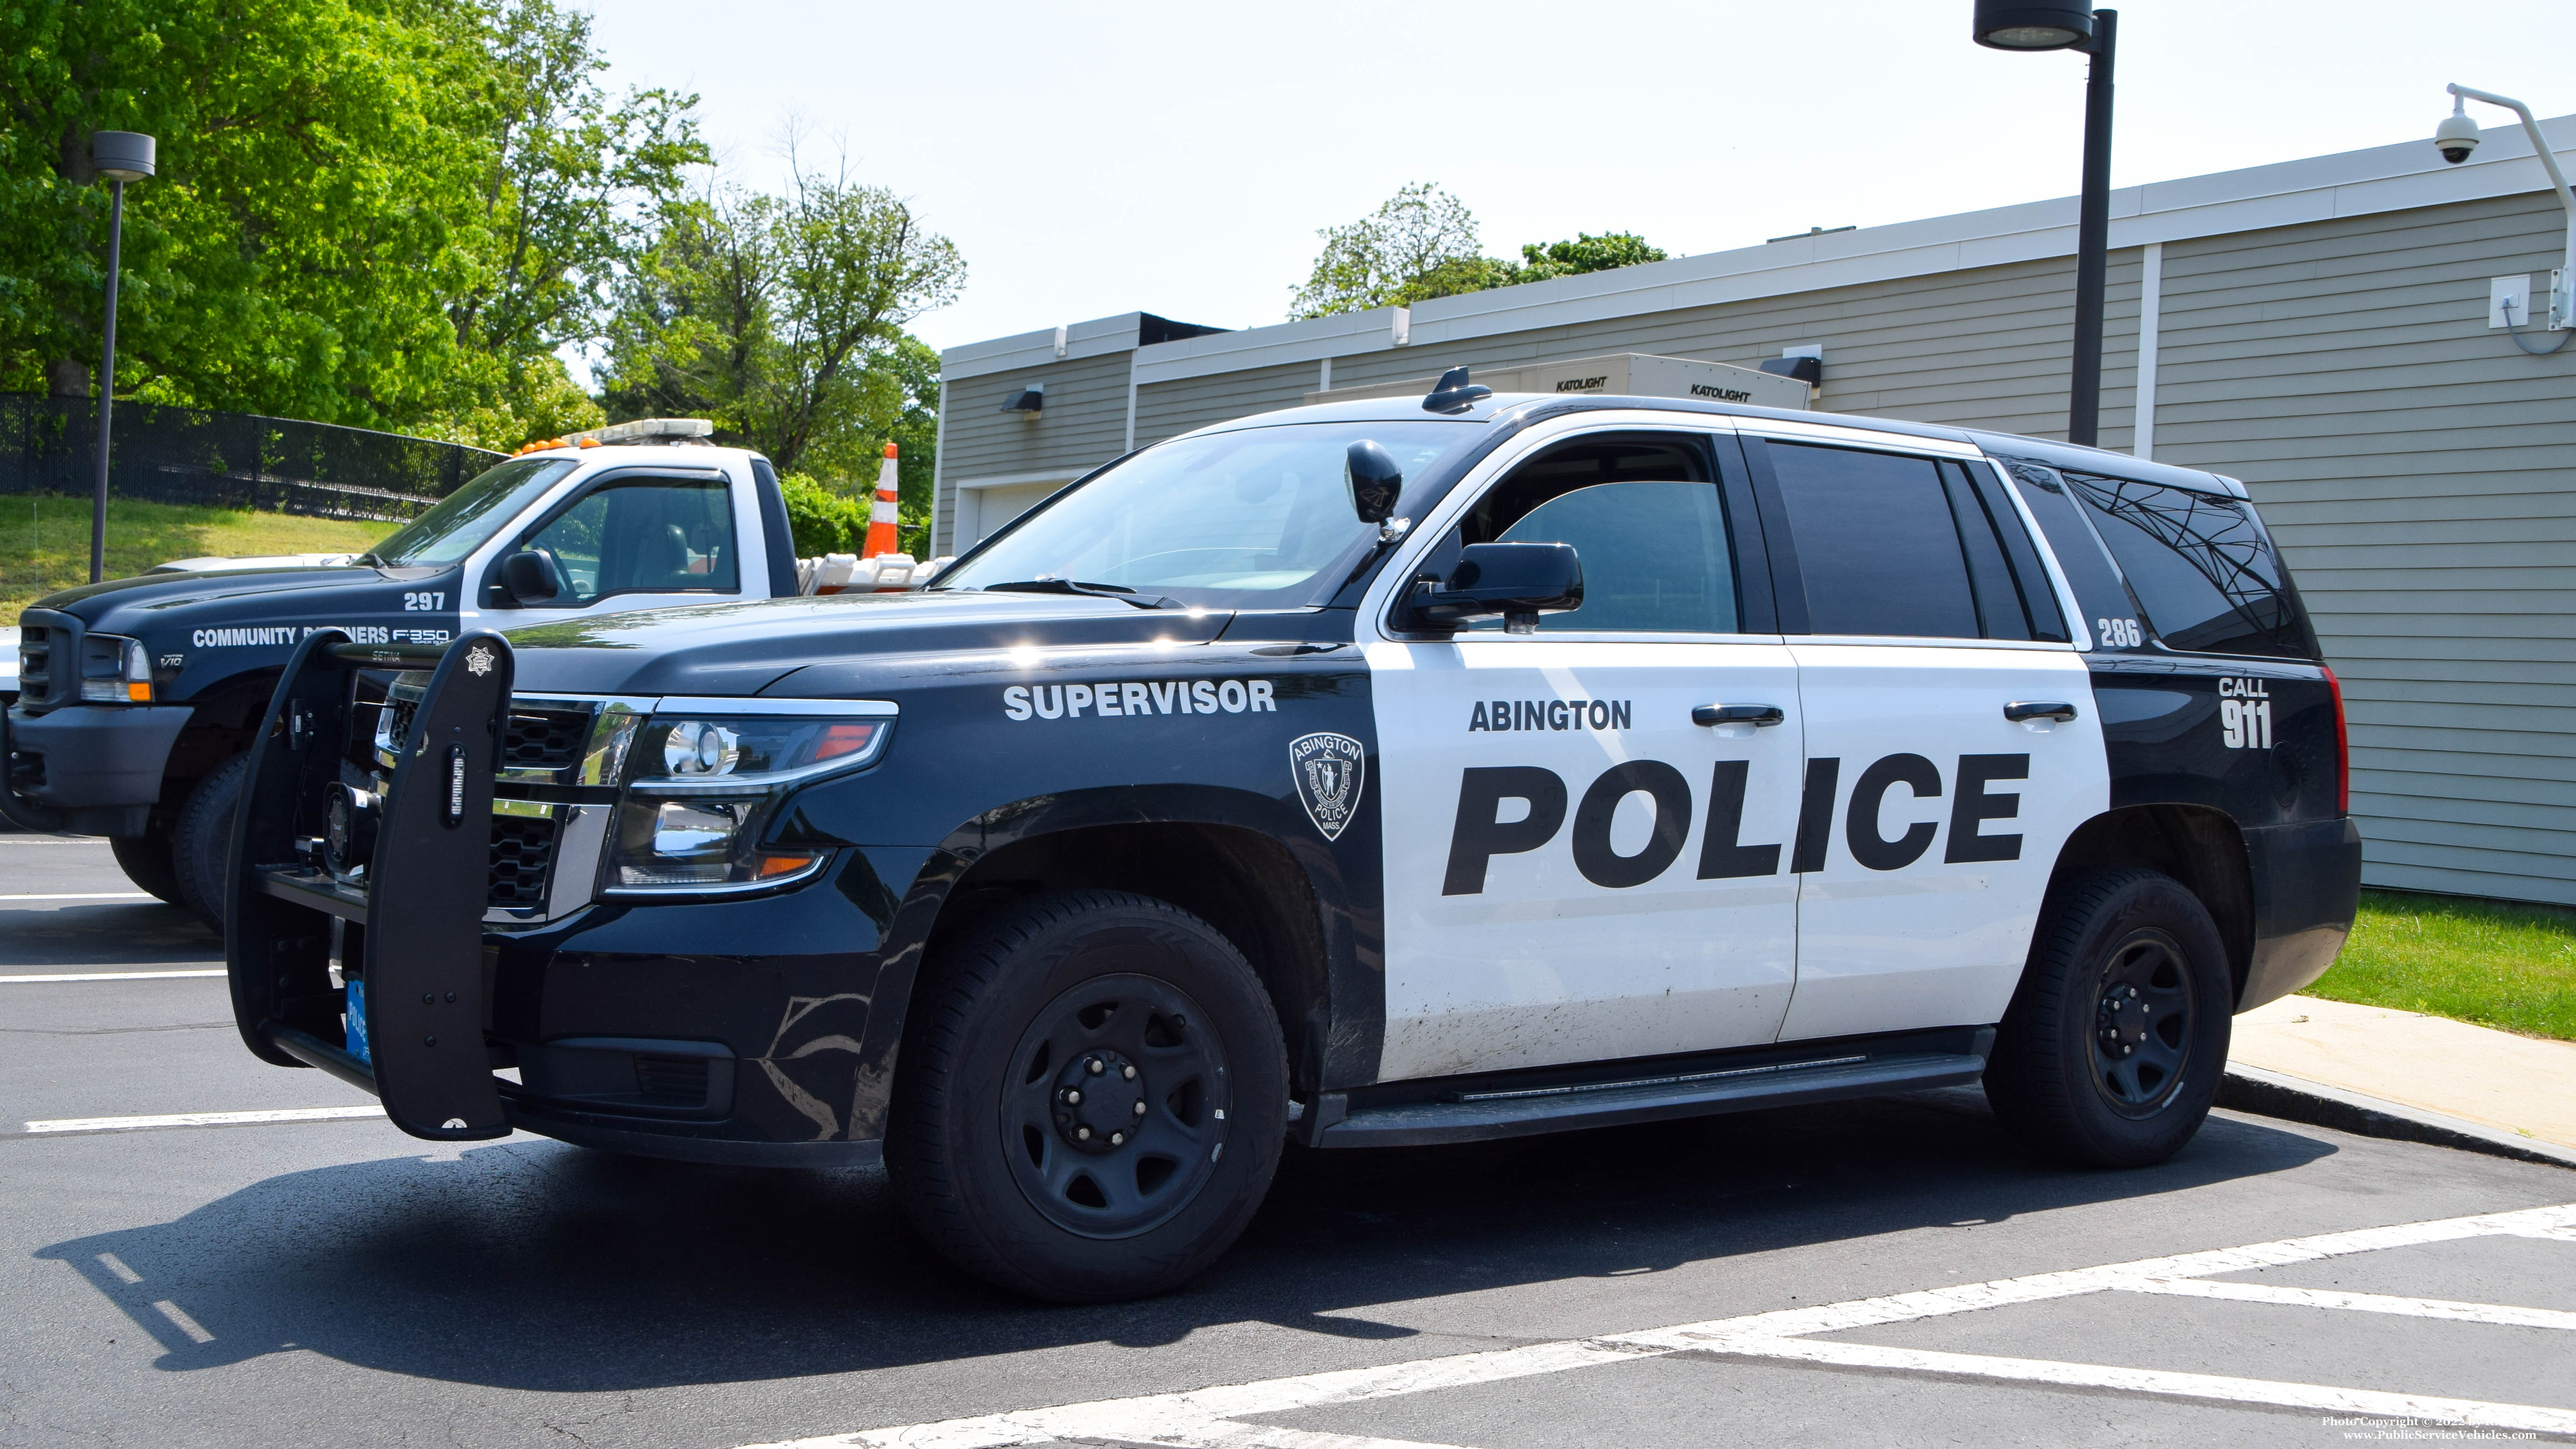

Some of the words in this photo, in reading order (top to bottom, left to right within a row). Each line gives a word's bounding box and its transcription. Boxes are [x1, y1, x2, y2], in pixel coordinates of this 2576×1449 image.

[1556, 376, 1608, 392] KATOLIGHT
[1690, 384, 1751, 403] KATOLIGHT
[404, 592, 445, 610] 297
[193, 627, 296, 647] COMMUNITY
[2098, 618, 2141, 647] 286
[160, 658, 182, 668] V10
[373, 651, 400, 662] SETINA
[2219, 678, 2268, 698] CALL
[1004, 680, 1277, 720] SUPERVISOR
[1468, 700, 1631, 732] ABINGTON
[2221, 700, 2271, 749] 911
[1295, 736, 1360, 761] ABINGTON
[1315, 803, 1348, 821] POLICE
[1441, 753, 2030, 896] POLICE
[349, 1001, 366, 1043] POLICE
